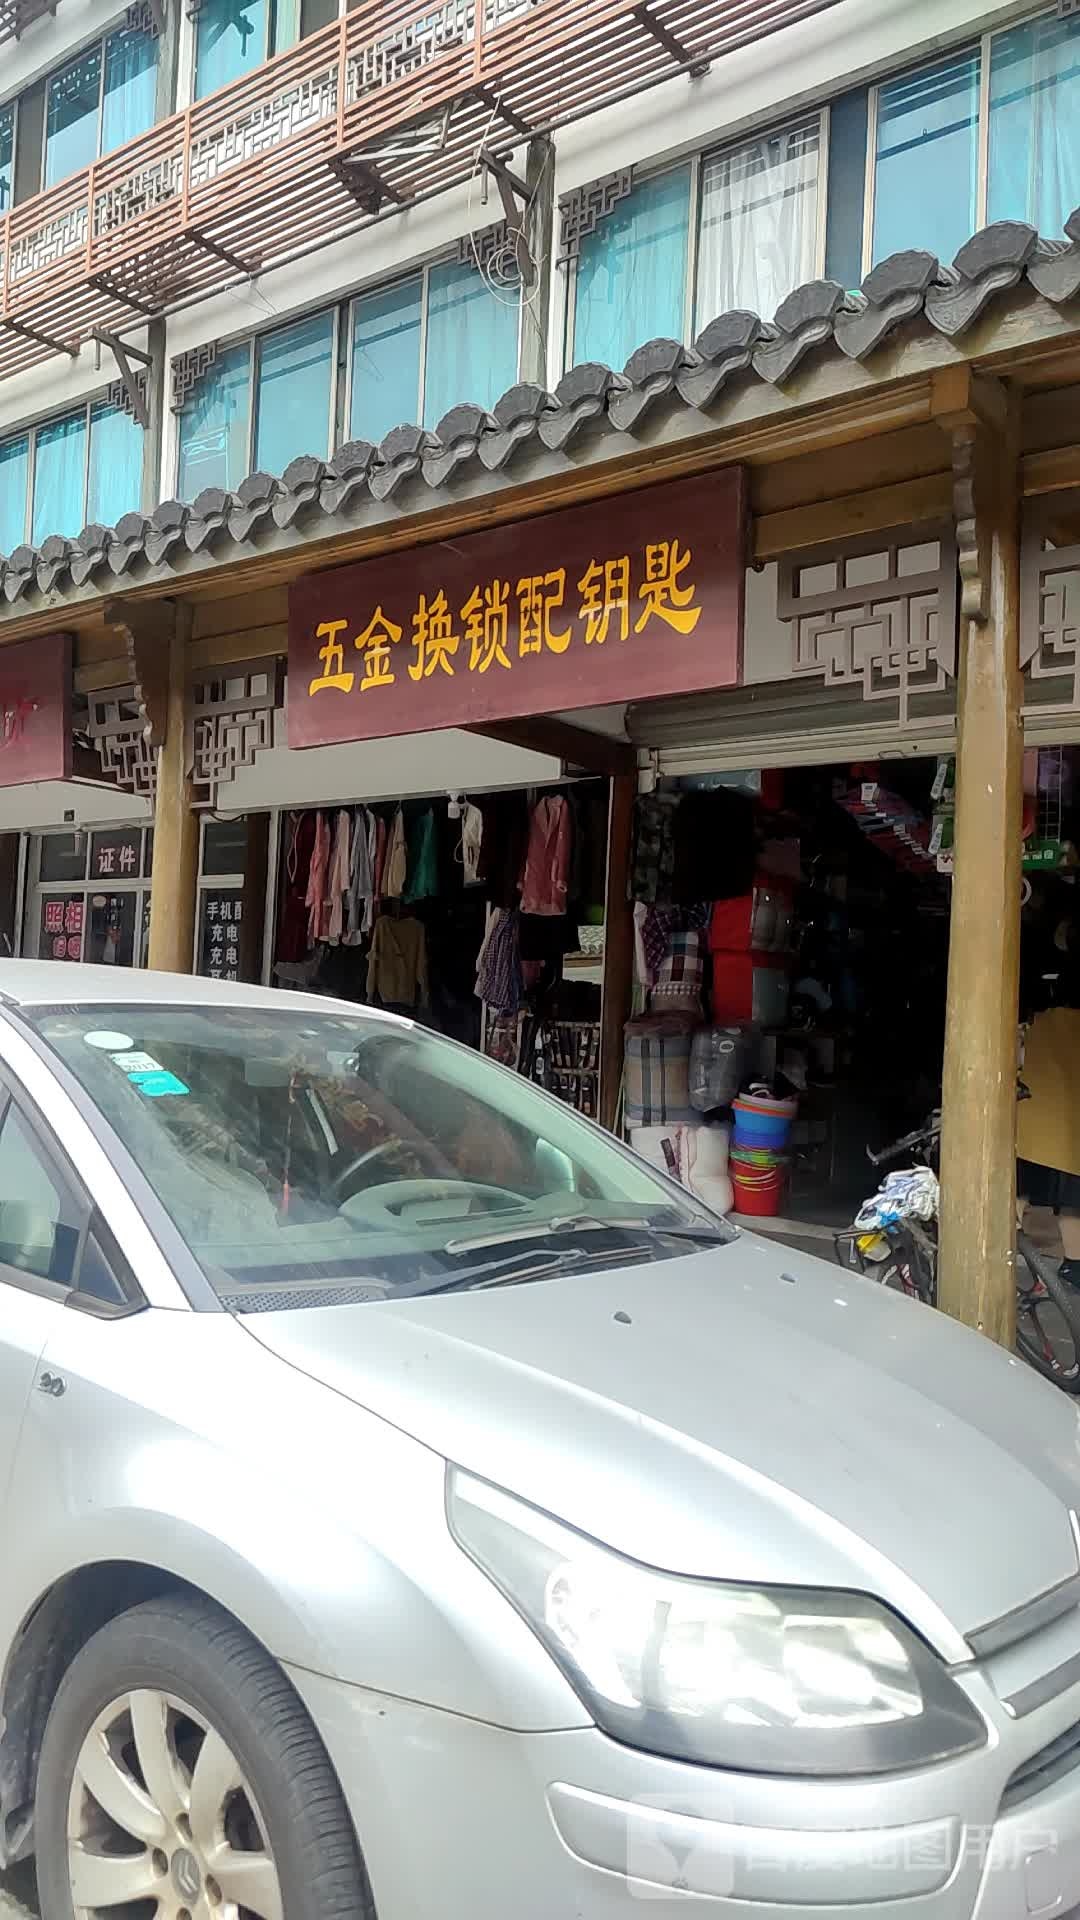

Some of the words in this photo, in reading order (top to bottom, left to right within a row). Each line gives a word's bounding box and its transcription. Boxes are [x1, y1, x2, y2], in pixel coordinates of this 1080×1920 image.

[309, 539, 702, 696] 五金换锁配钥匙
[98, 844, 136, 873] 证件
[211, 923, 239, 942] 充电
[210, 946, 238, 965] 充电
